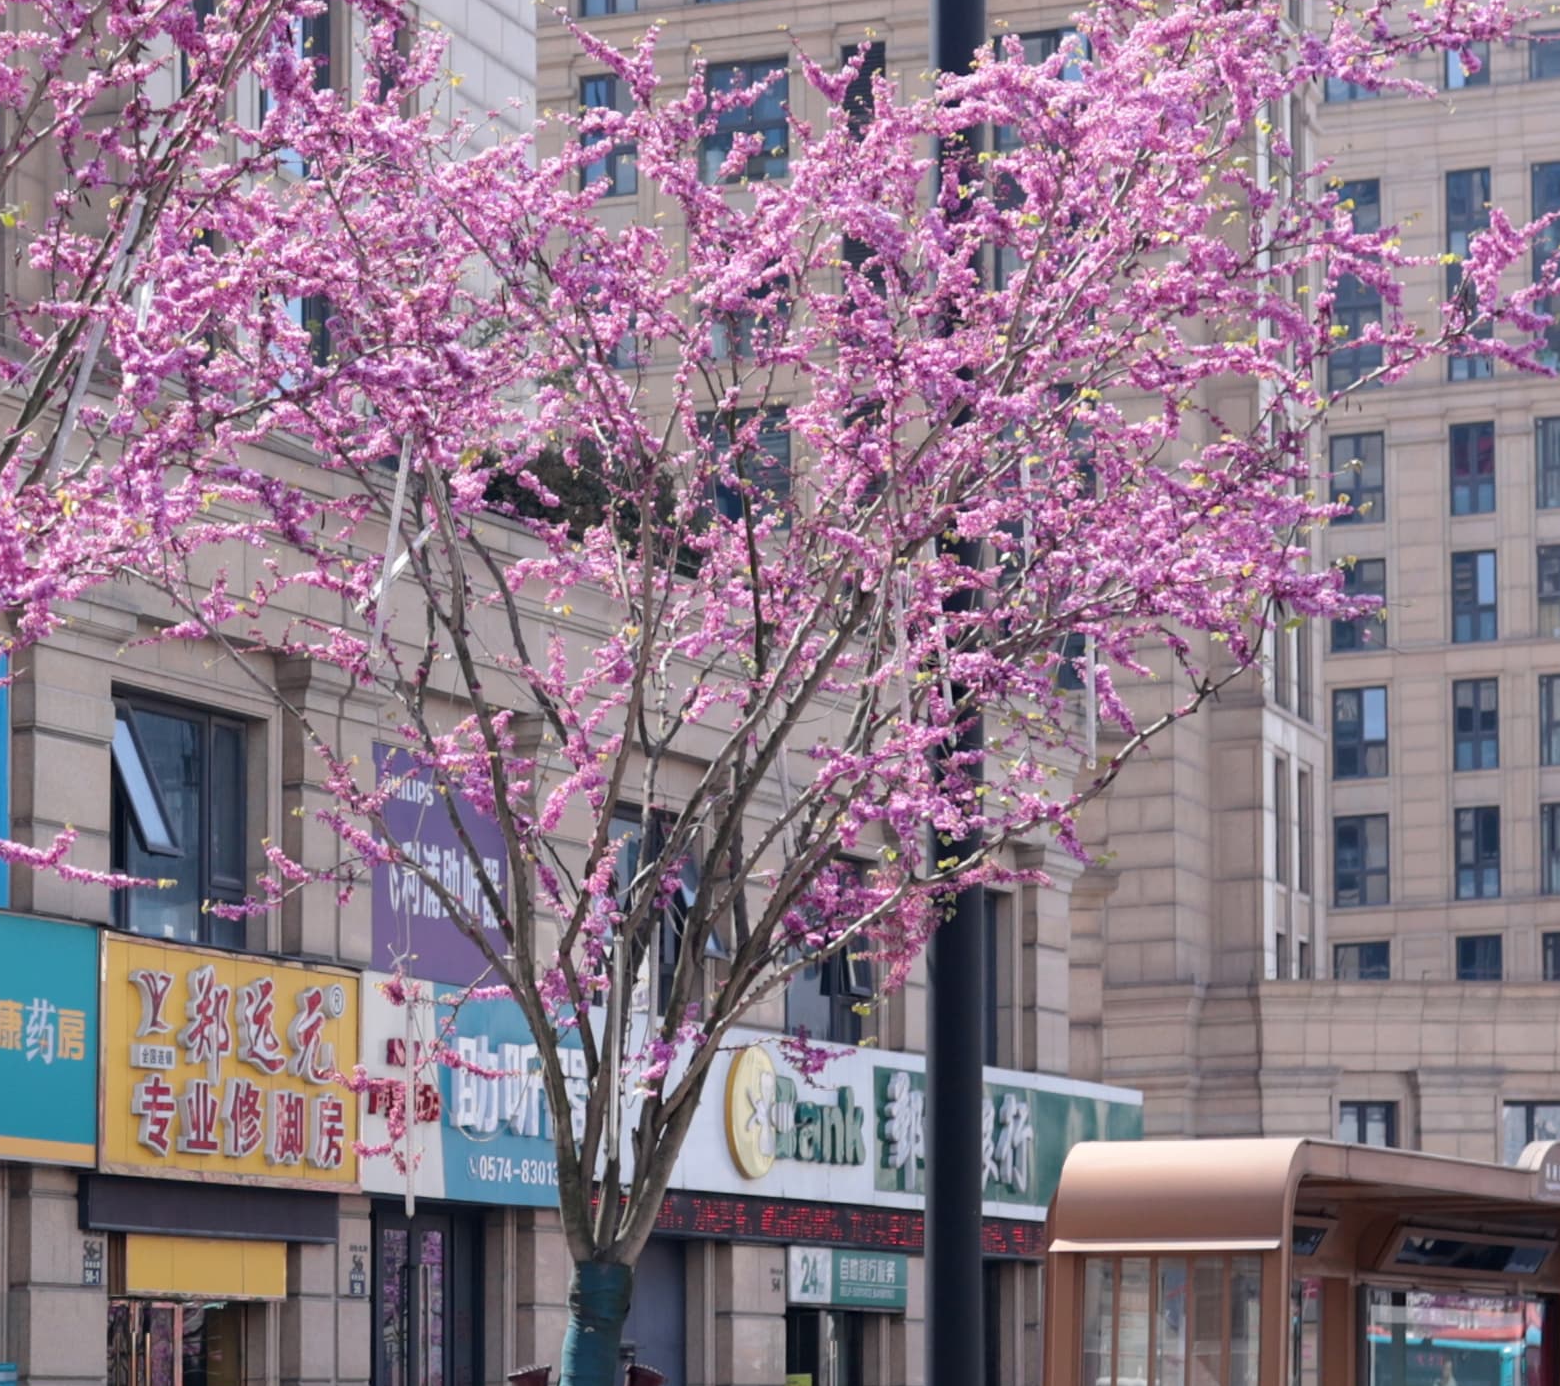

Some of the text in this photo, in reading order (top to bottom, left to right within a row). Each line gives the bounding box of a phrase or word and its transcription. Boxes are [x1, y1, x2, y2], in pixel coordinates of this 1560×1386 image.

[135, 1074, 345, 1169] 专业修脚房
[840, 1256, 896, 1284] 自助银行服务
